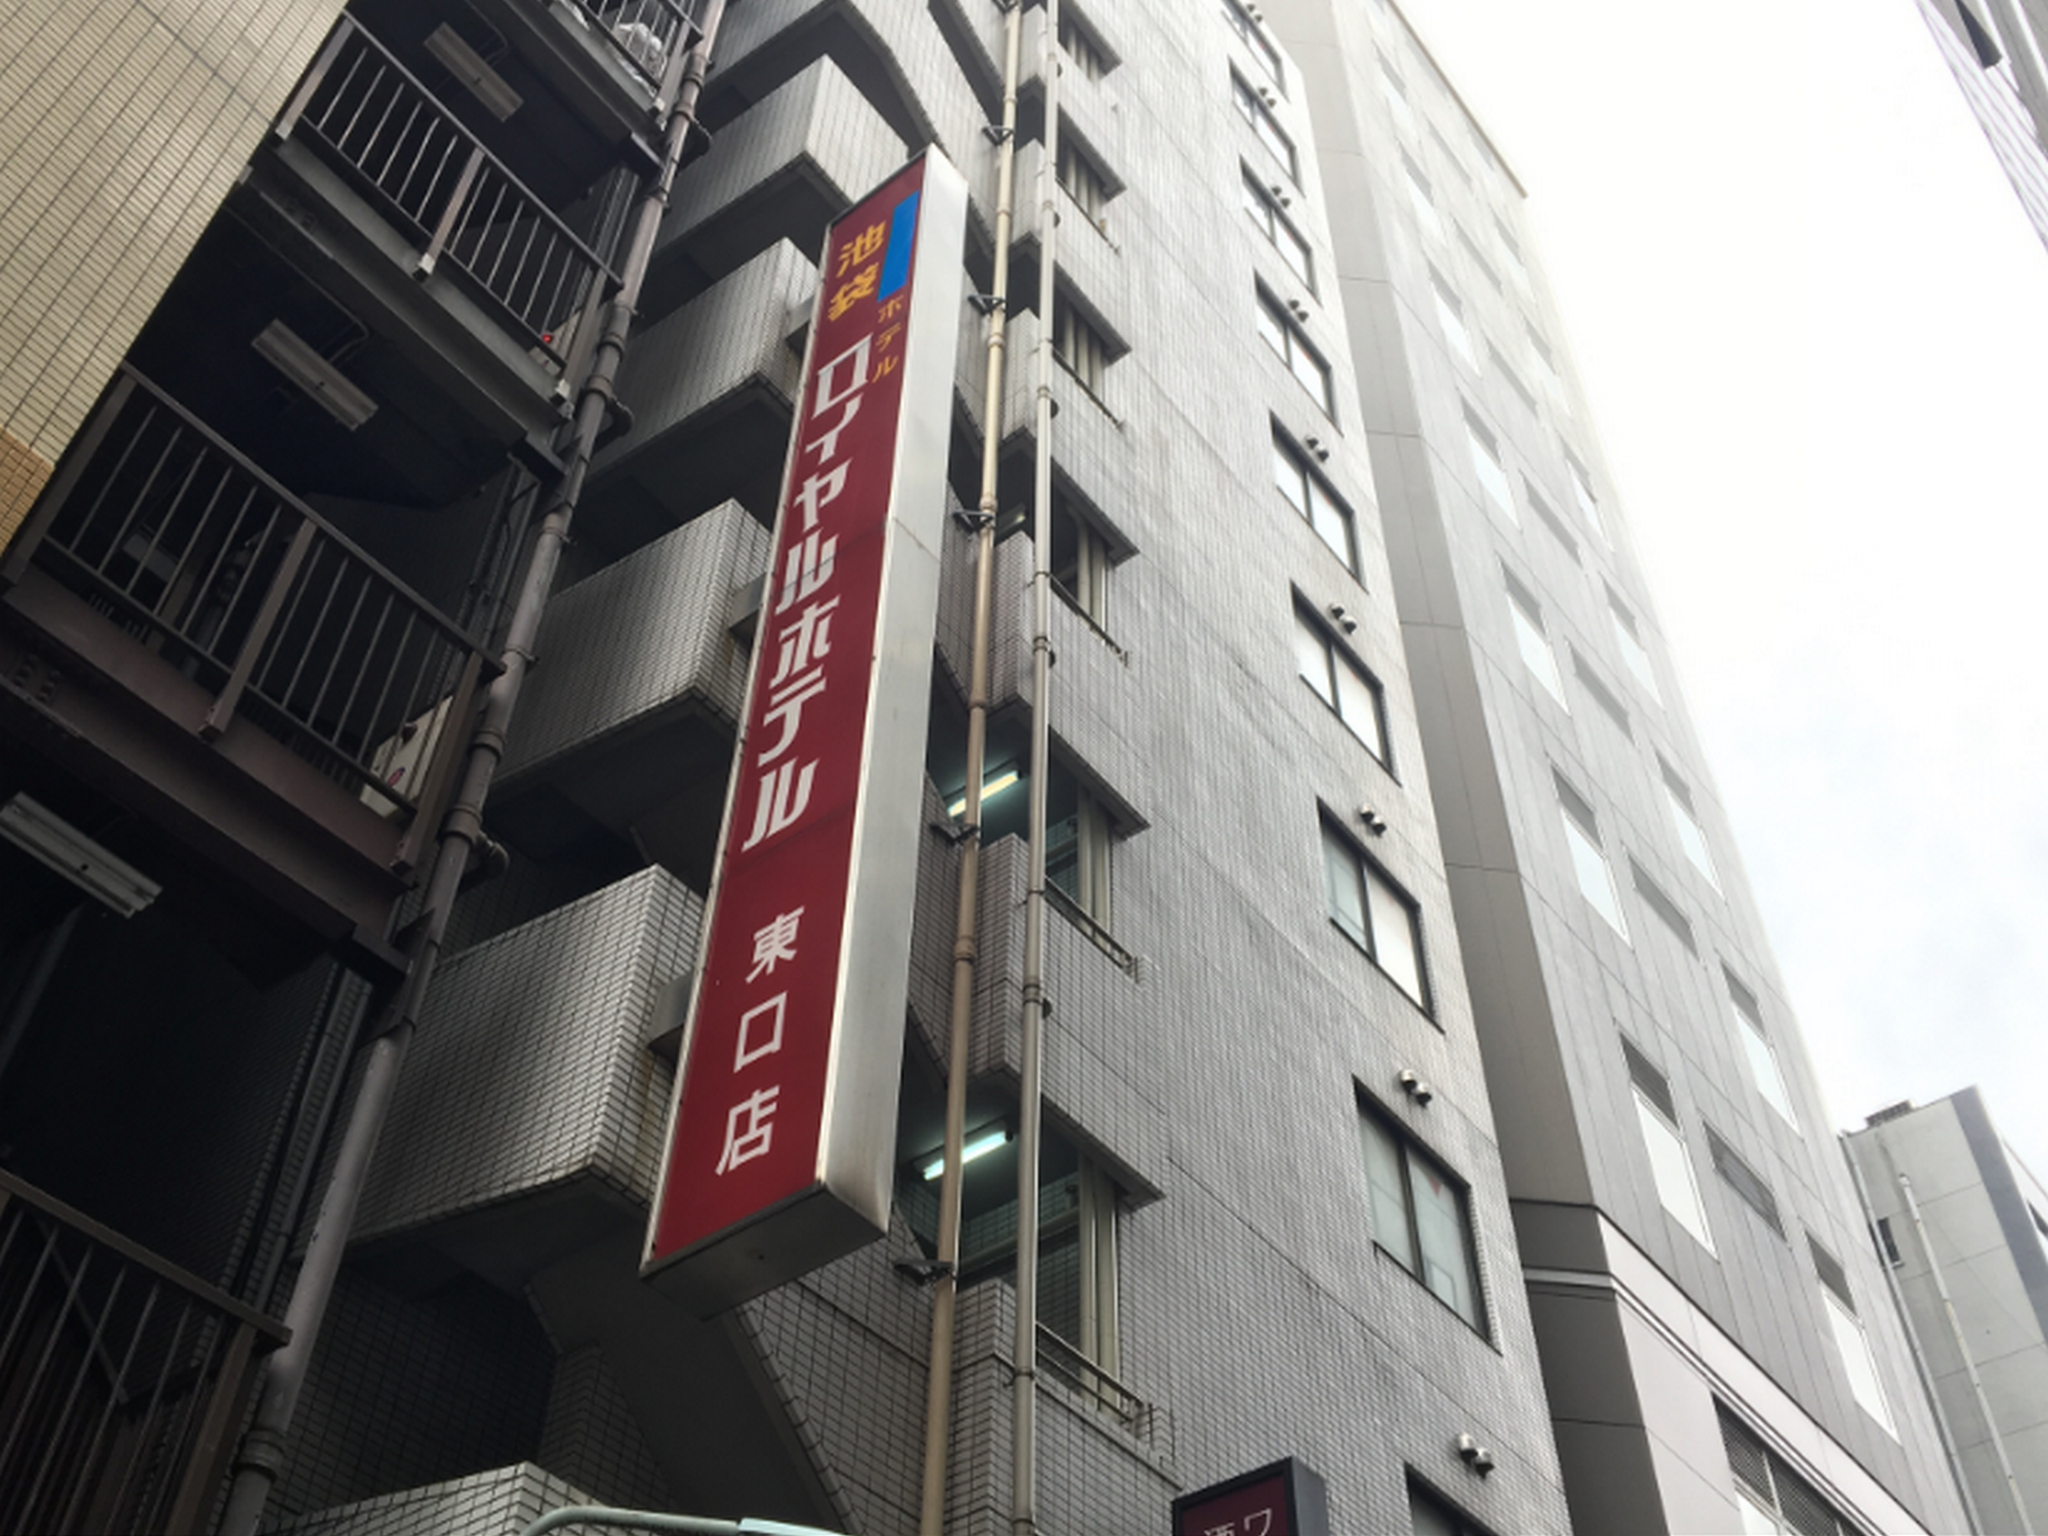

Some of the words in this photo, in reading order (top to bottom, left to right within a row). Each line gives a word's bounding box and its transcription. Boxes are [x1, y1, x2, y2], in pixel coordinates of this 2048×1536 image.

[828, 221, 886, 322] 池袋
[872, 295, 904, 384] ホテル
[741, 333, 873, 853] ロイヤルホテル
[715, 905, 804, 1176] 東口店
